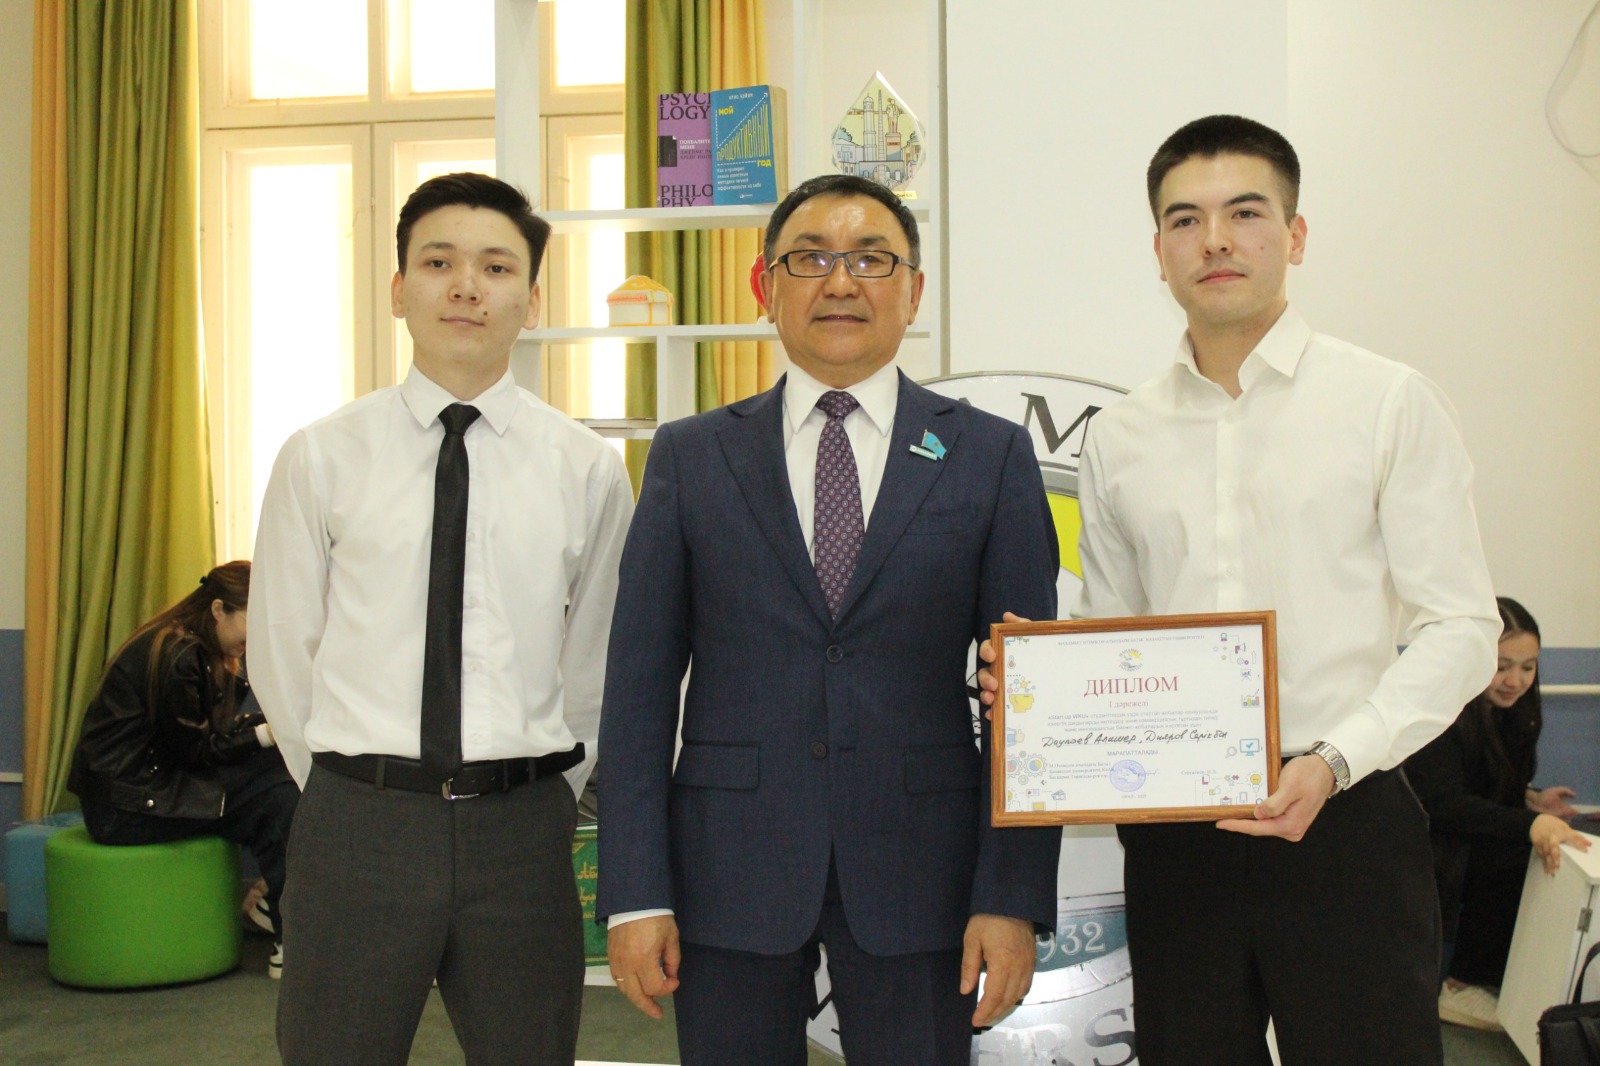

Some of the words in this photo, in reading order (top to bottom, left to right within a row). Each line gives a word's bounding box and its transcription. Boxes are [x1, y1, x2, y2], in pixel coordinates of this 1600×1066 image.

[660, 105, 710, 120] LOGY
[718, 105, 734, 116] МОЙ
[716, 102, 770, 161] ПРОДУКТИВНЫЙ
[757, 159, 772, 168] ГОД
[661, 184, 713, 198] PHILO
[1084, 676, 1178, 698] ДИПЛОМ
